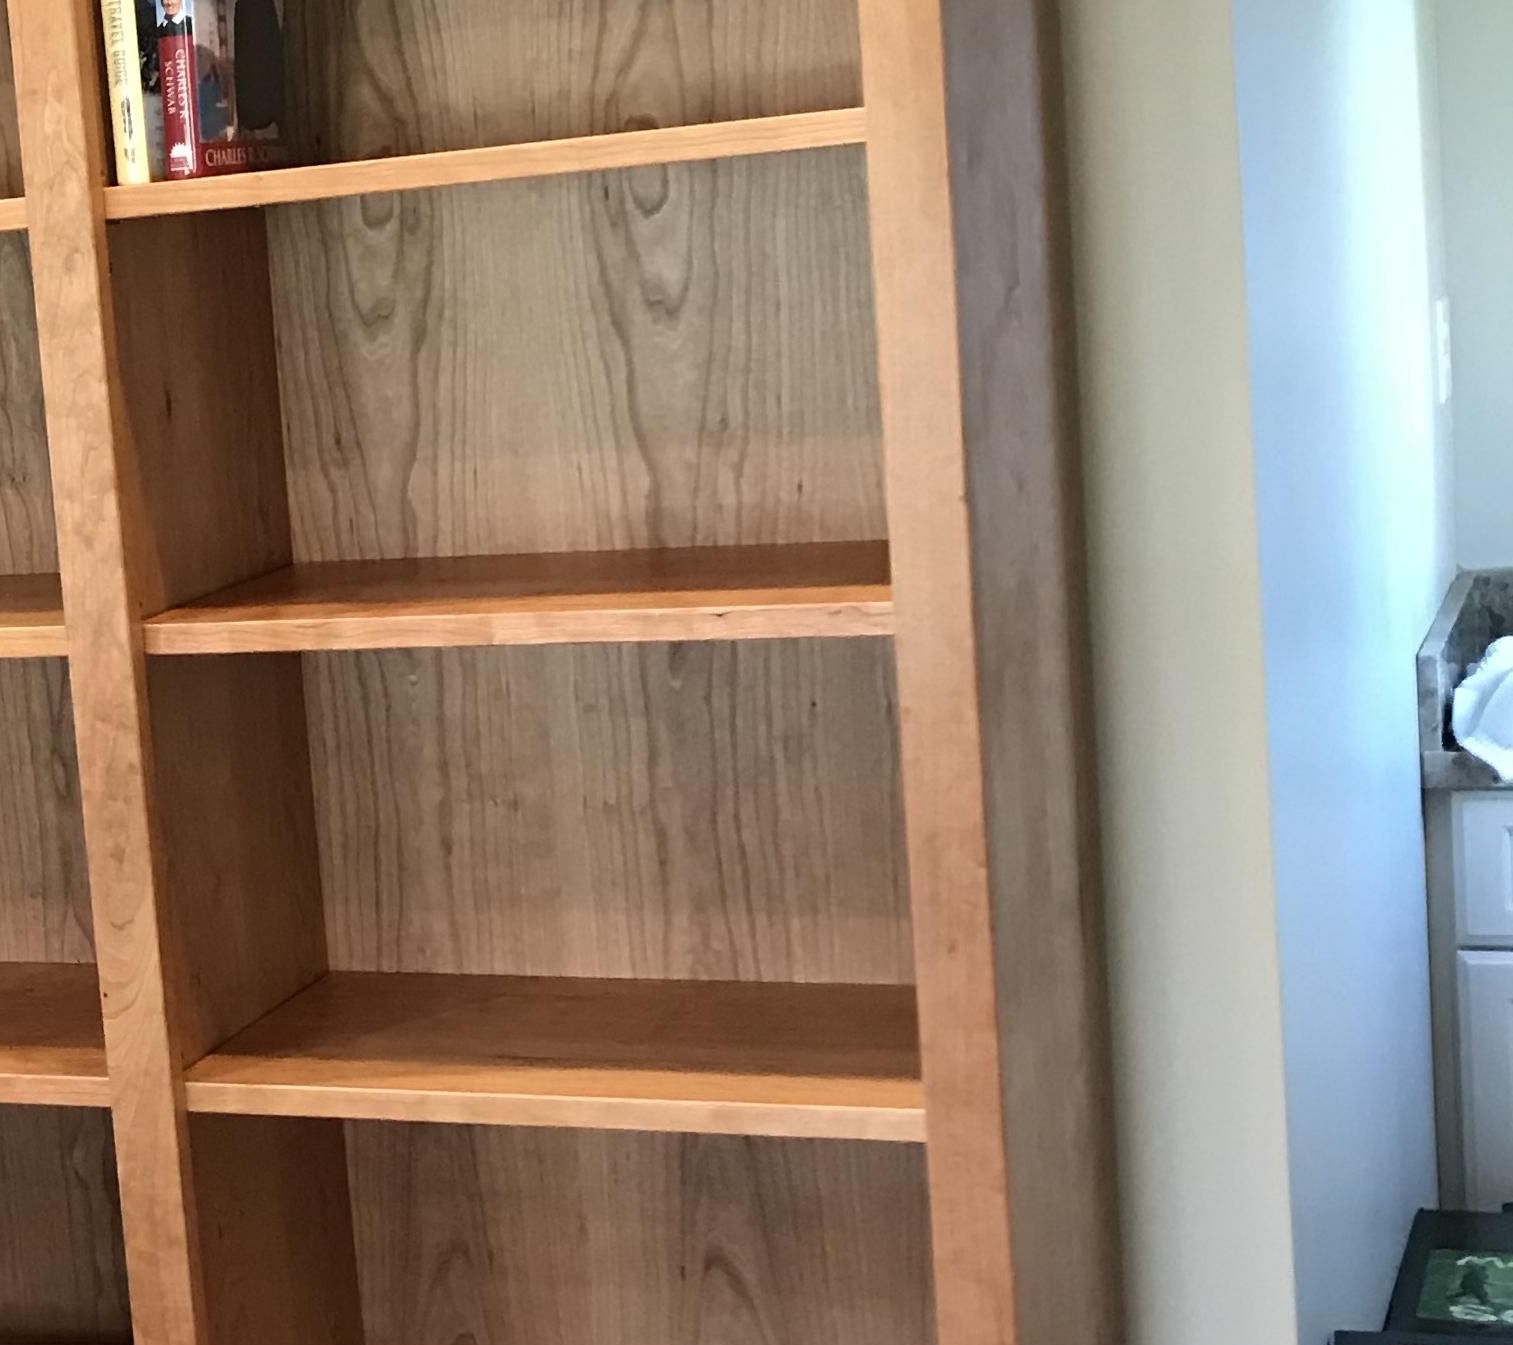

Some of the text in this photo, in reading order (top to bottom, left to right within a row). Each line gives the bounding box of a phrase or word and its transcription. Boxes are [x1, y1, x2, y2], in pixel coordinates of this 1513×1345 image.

[106, 0, 125, 48] TRAVEL
[164, 60, 177, 116] SCHWAB
[205, 147, 247, 167] CHARLES
